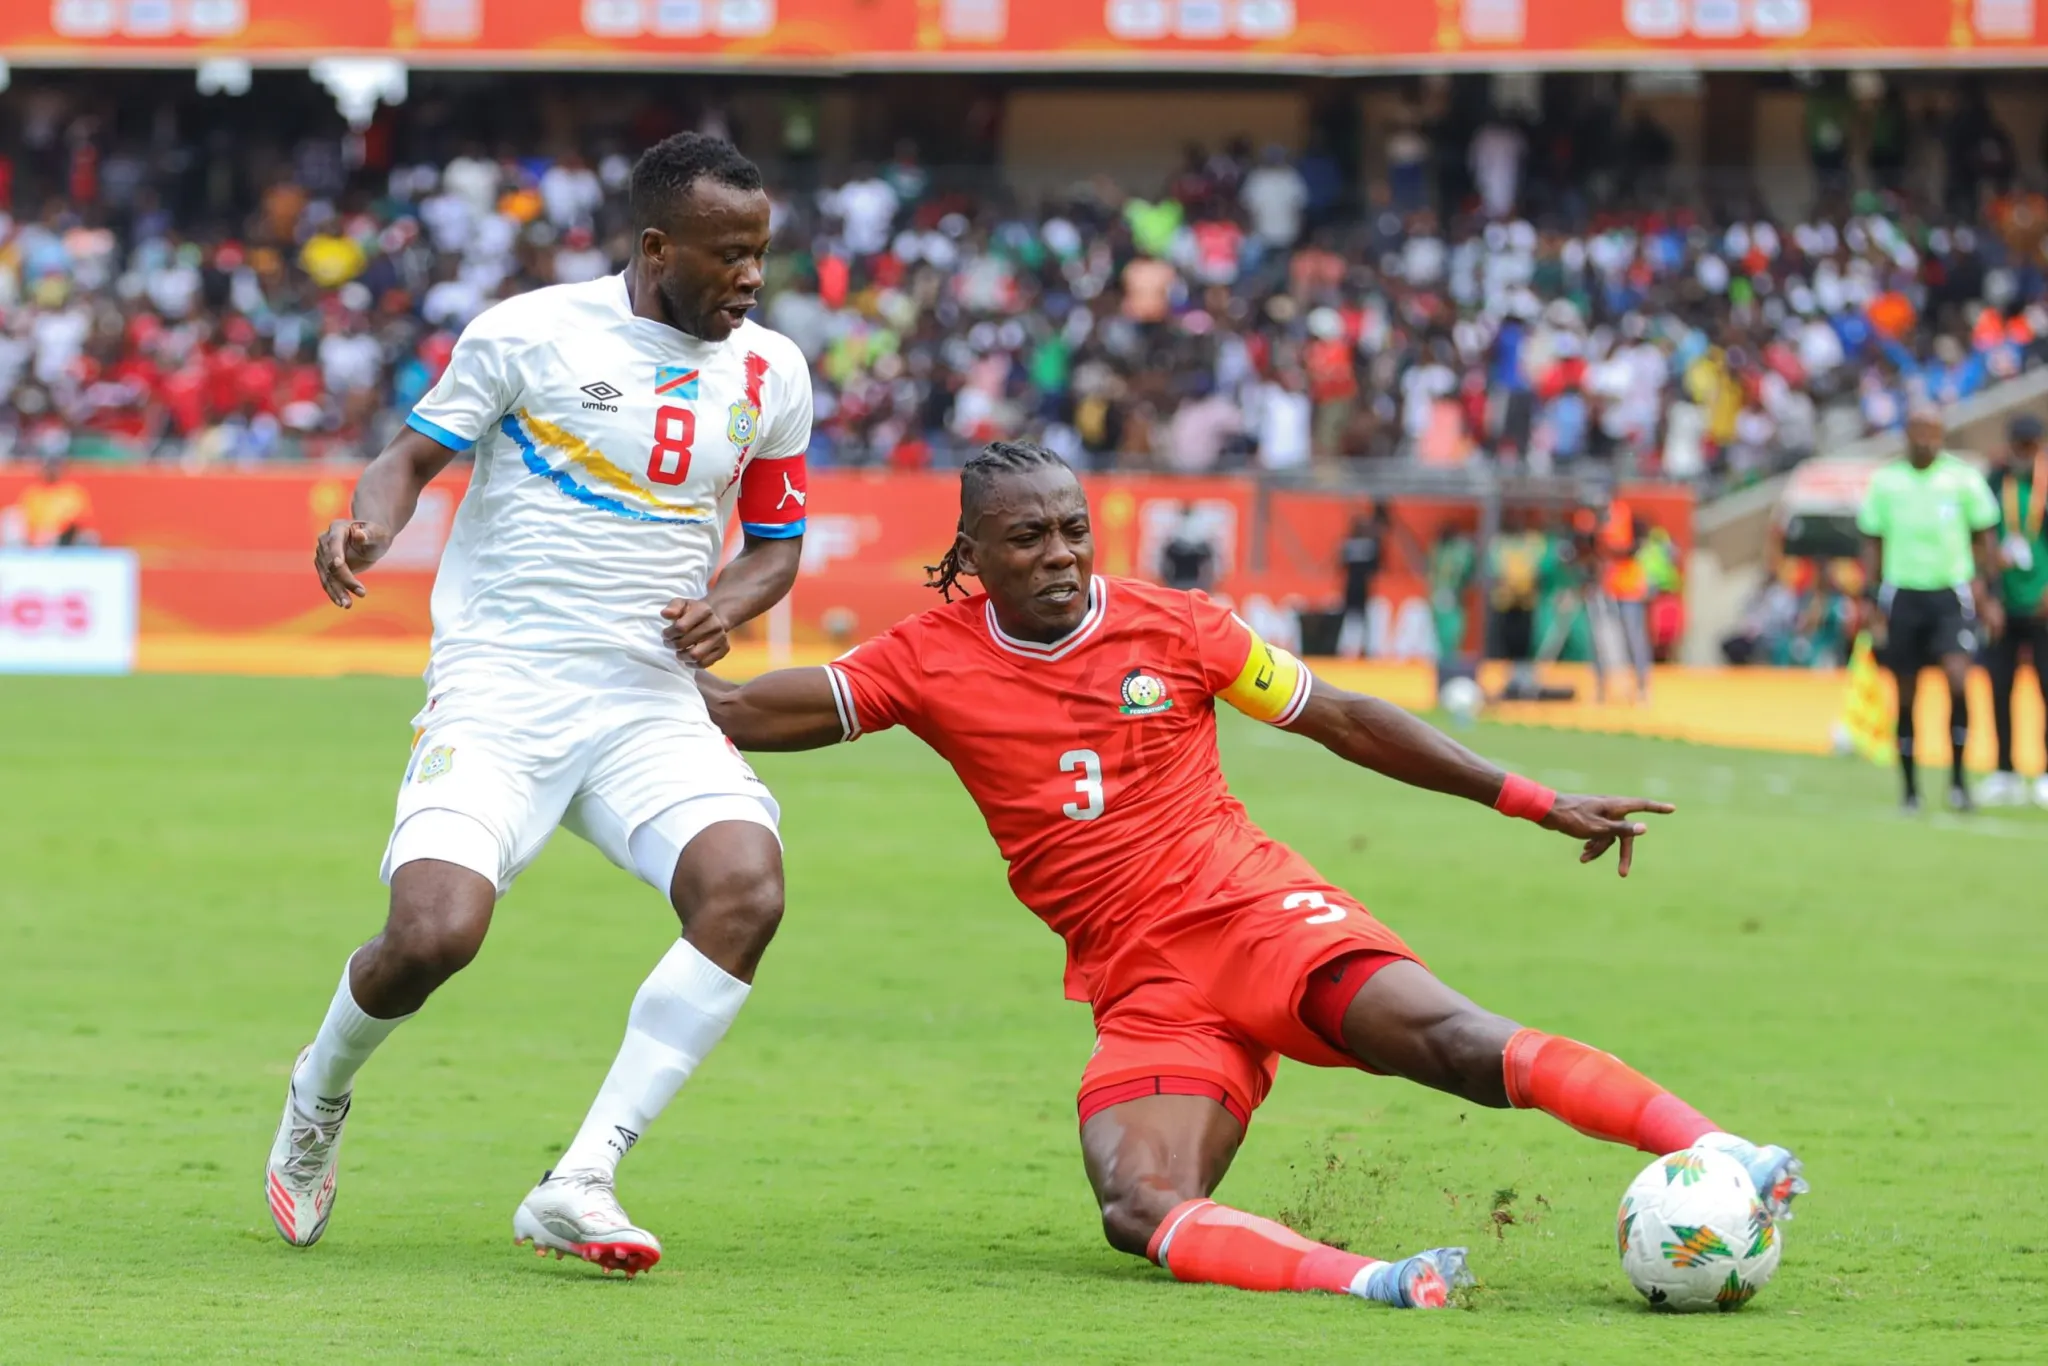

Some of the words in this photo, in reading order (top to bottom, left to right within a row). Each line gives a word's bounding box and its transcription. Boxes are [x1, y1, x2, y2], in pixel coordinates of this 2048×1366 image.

[581, 401, 618, 413] umbro
[646, 405, 695, 485] 8
[1059, 749, 1104, 820] 3
[1283, 892, 1346, 924] 3
